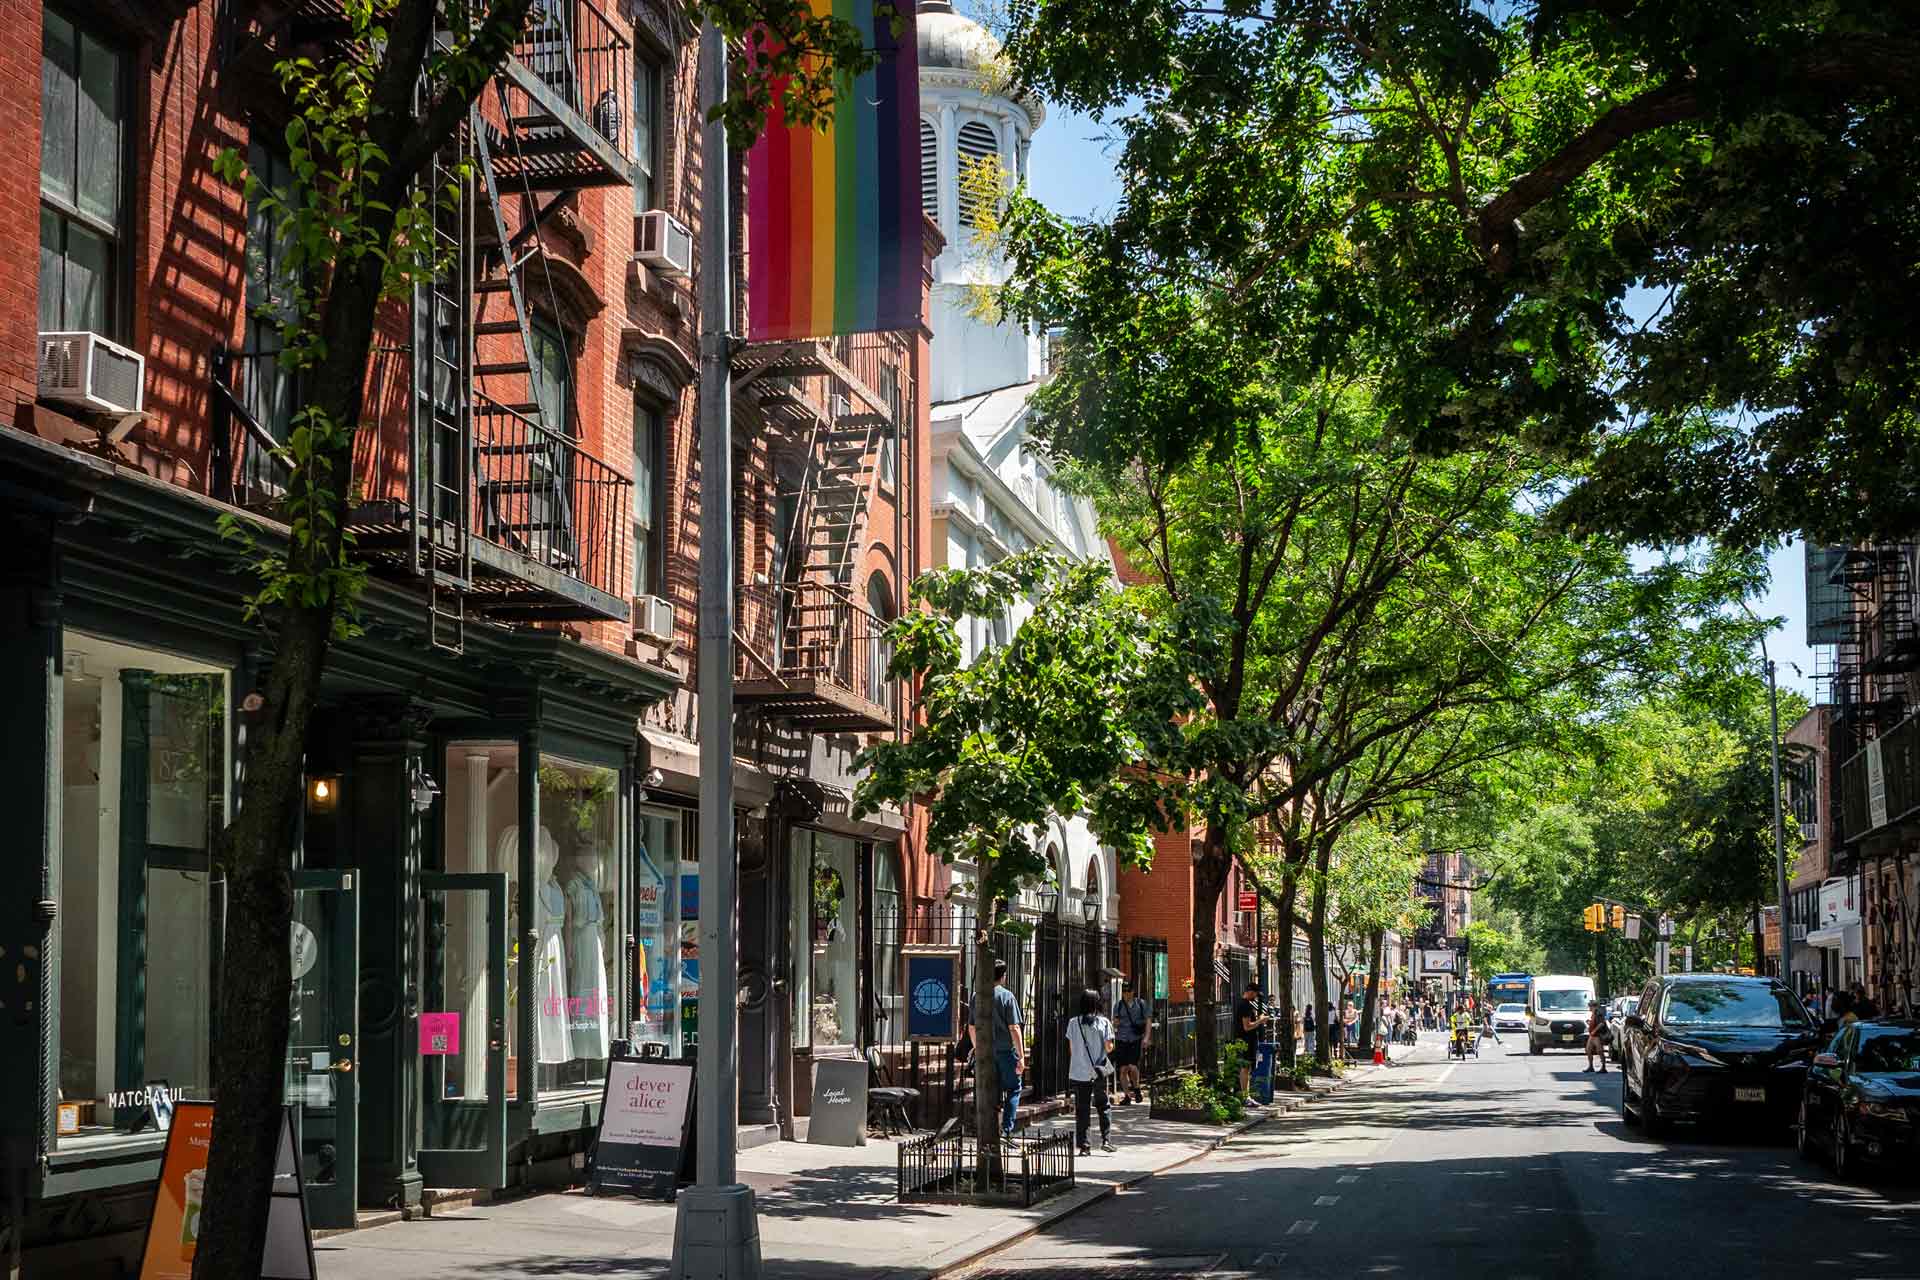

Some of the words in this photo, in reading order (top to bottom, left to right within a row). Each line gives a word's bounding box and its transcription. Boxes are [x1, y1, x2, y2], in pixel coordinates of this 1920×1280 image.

[543, 985, 582, 1017] clever
[585, 986, 615, 1017] alice
[626, 1075, 675, 1093] clever
[629, 1093, 665, 1109] alice
